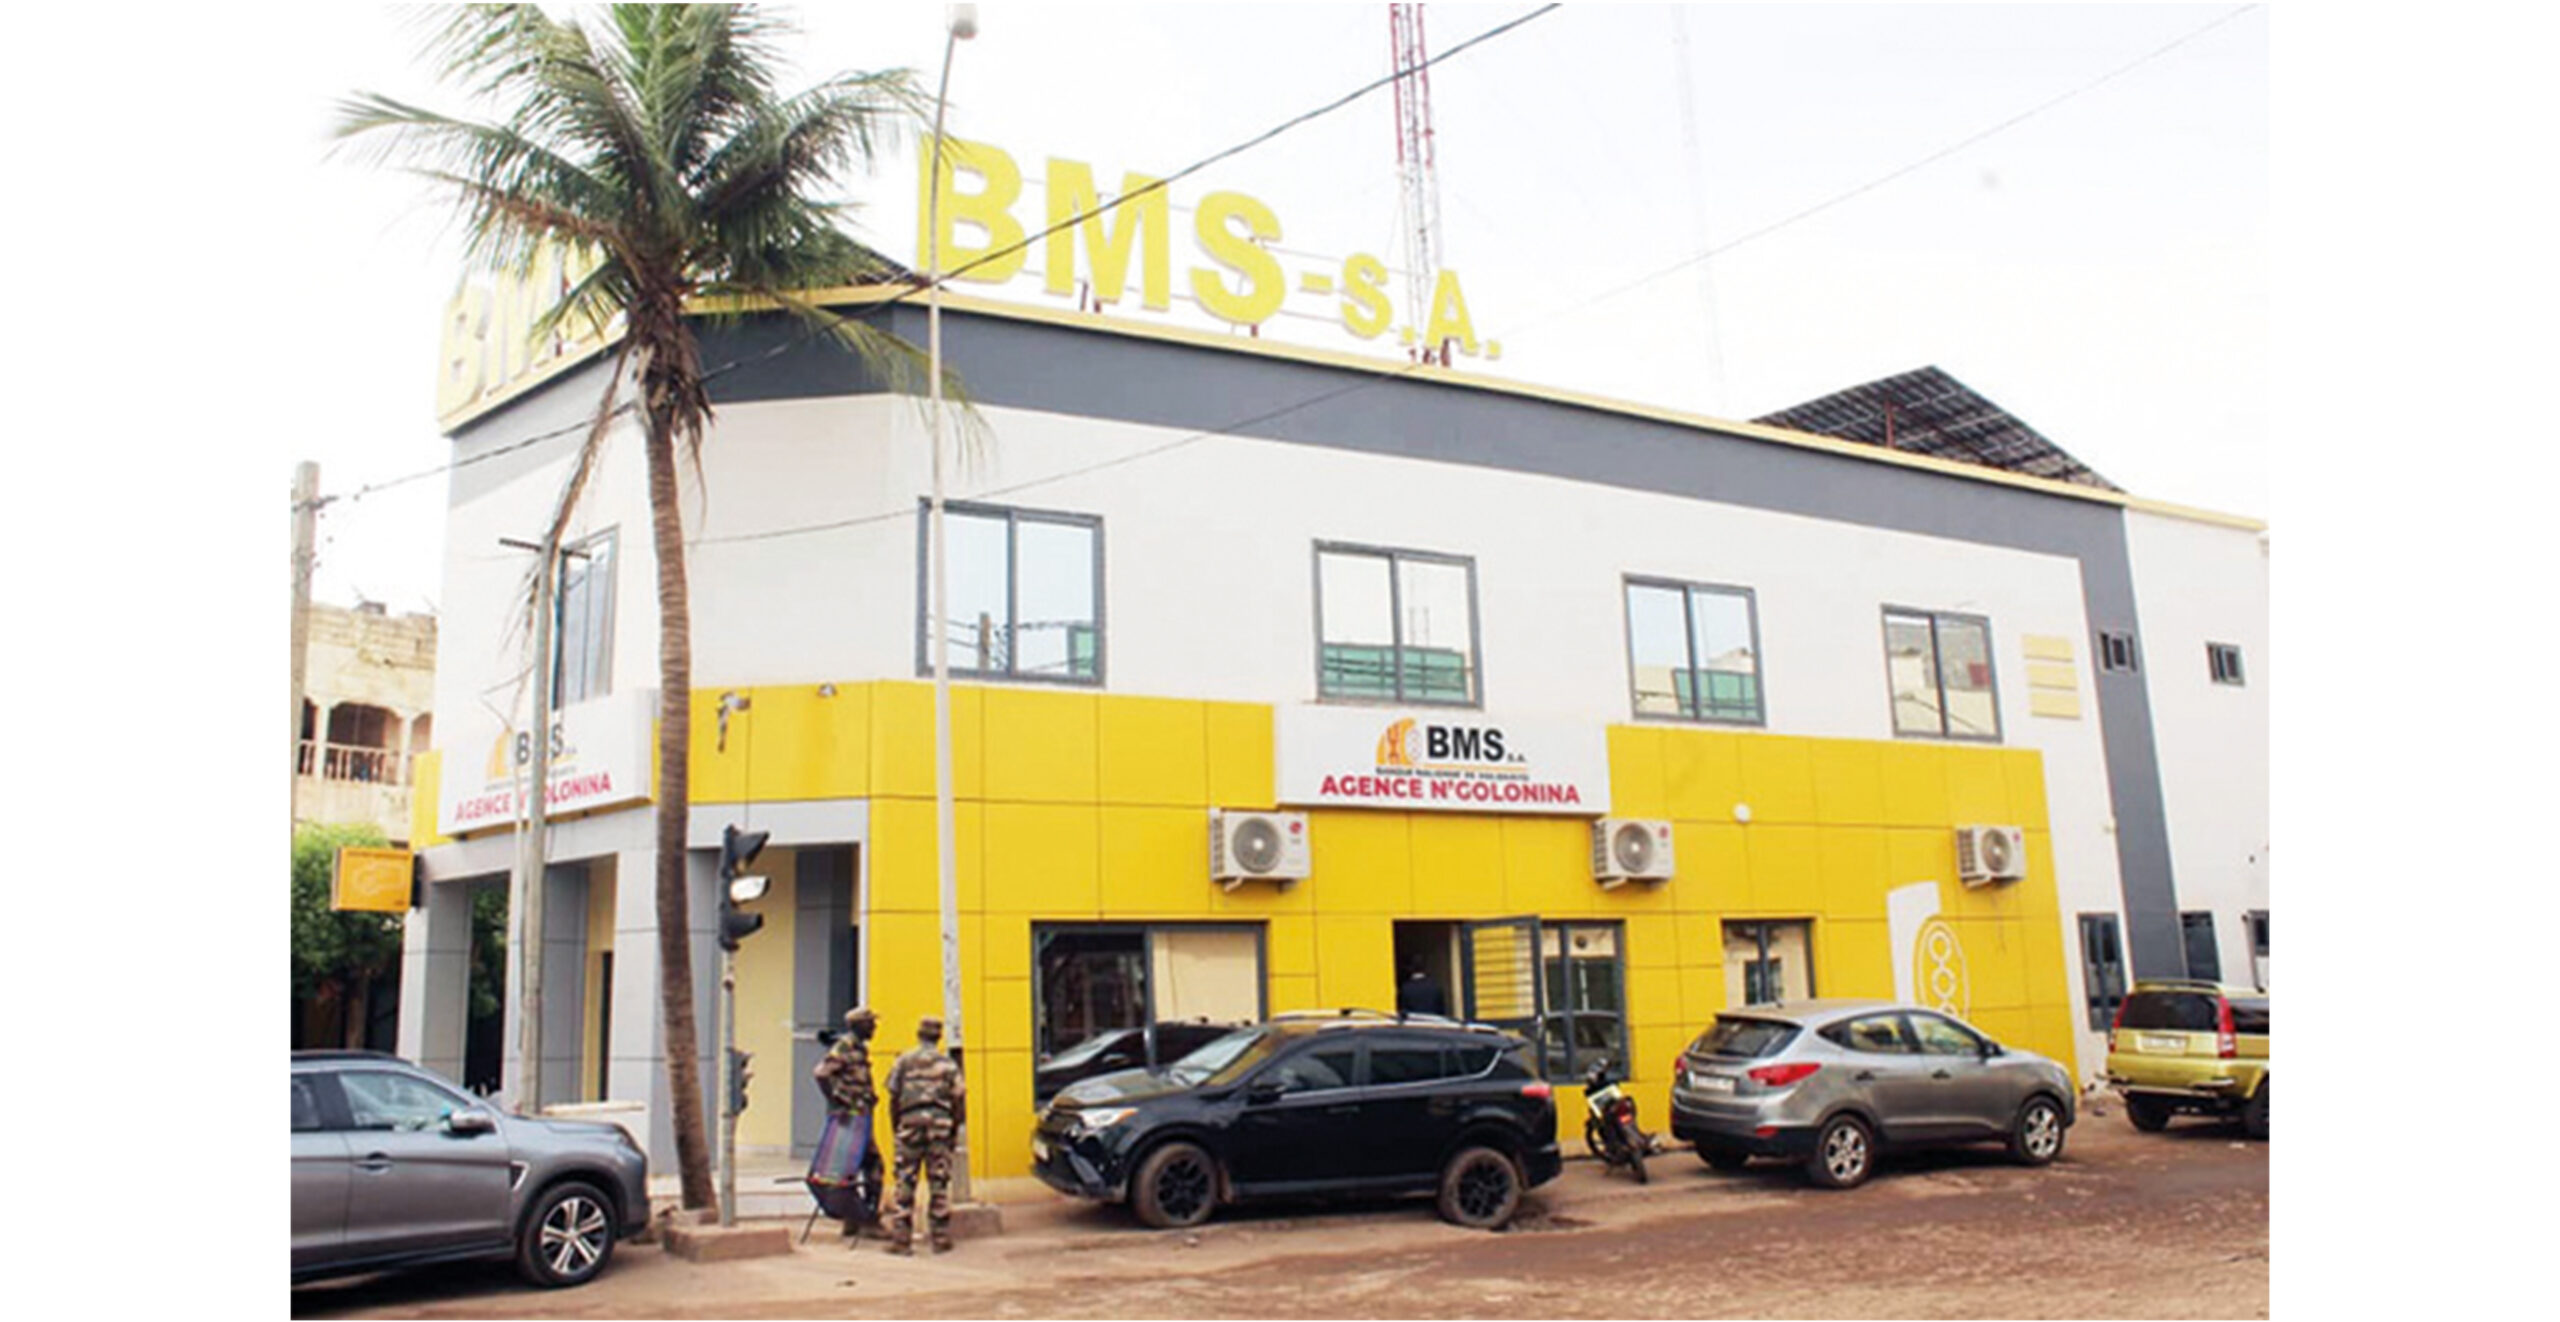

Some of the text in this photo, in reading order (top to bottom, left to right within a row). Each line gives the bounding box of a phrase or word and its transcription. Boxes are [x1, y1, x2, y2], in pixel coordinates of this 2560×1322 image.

[515, 723, 564, 766] BS
[1426, 726, 1505, 762] BMS
[1321, 775, 1581, 804] AGENCE N'GOLONINA
[454, 792, 512, 821] AGENCE
